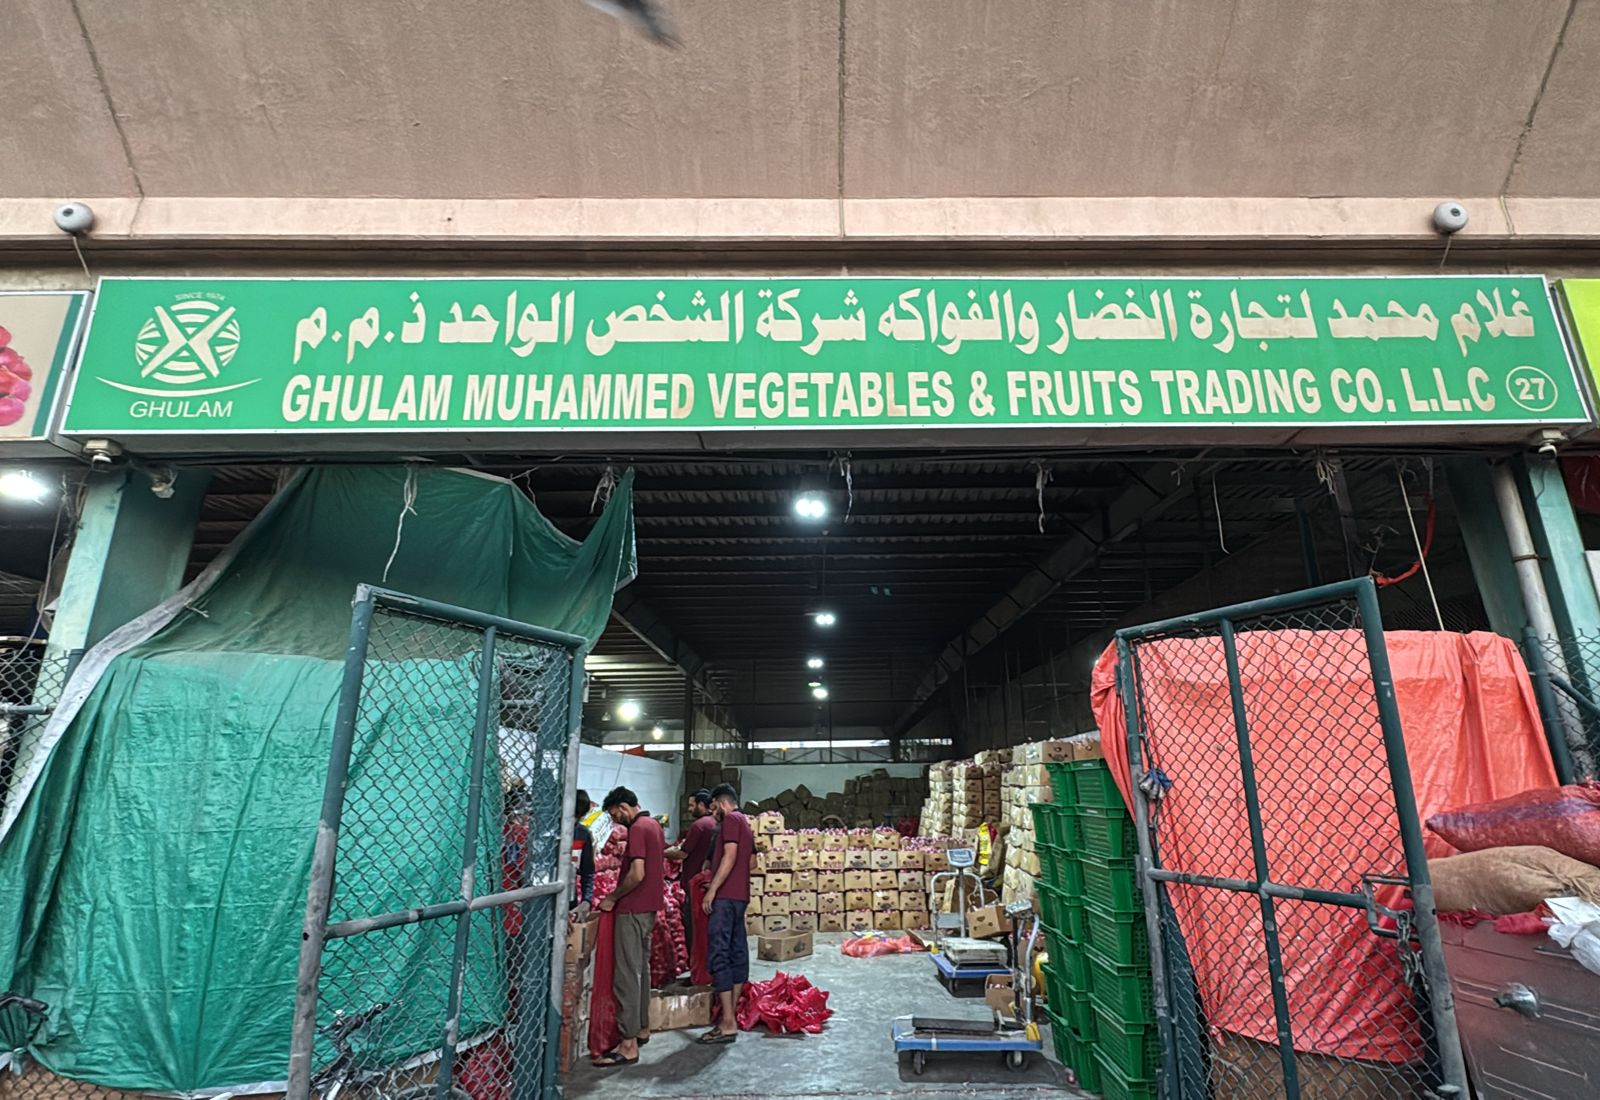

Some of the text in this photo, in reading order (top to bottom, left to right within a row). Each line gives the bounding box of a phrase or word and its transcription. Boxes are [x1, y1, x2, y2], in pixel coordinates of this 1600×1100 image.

[438, 290, 575, 358] الواحد
[585, 289, 745, 357] الشخص
[755, 288, 867, 356] شركة
[878, 288, 1040, 355] والفواكه
[1047, 288, 1178, 354] الخضار
[1187, 288, 1318, 353] لتجارة
[1327, 298, 1440, 341] محمد
[1450, 288, 1535, 357] غلام
[129, 400, 233, 418] GHULAM
[281, 366, 1496, 422] GHULAM MUHAMMED VEGETABLES & FRUITS TRADING CO. L.L.C
[1514, 377, 1545, 401] 27
